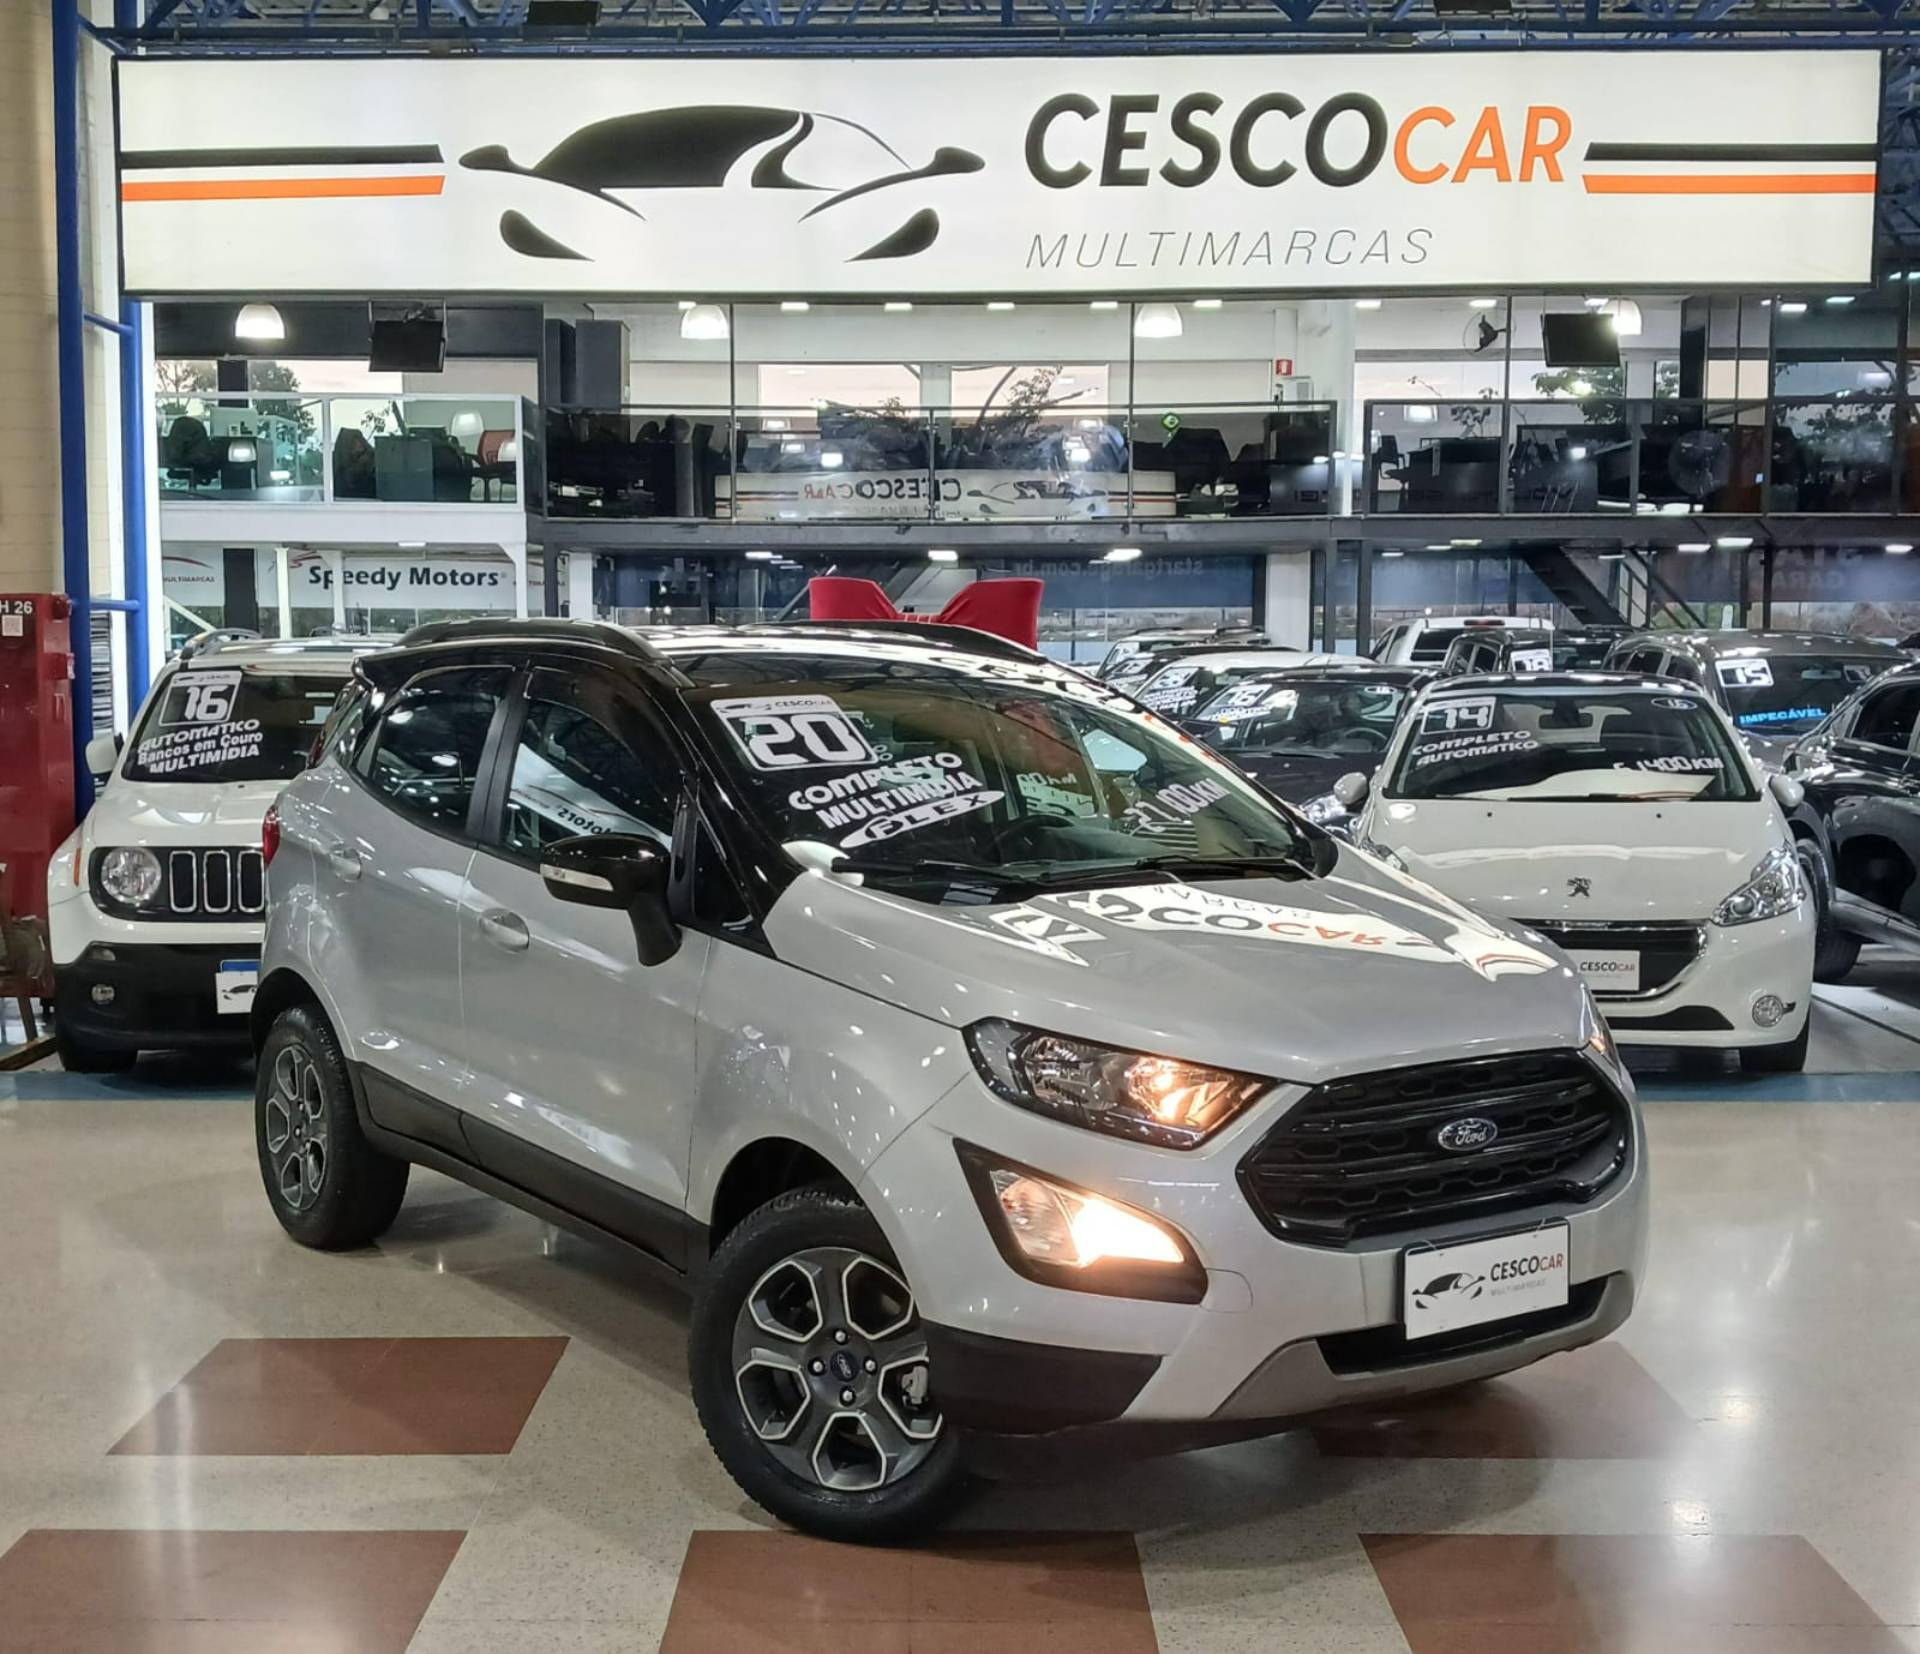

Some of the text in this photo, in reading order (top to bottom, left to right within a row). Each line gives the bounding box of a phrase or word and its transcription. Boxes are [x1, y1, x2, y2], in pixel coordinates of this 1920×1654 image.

[1024, 92, 1572, 188] CESCOCAR
[1026, 228, 1436, 269] MULTIMARCAS
[309, 566, 499, 590] Speedy Motors
[14, 601, 33, 614] 26
[184, 684, 229, 721] 16
[1444, 706, 1489, 730] 14
[137, 732, 263, 766] Bancos em Couro
[739, 712, 867, 766] 20
[1412, 730, 1532, 756] COMPLETO
[788, 752, 963, 811] COMPLETO
[867, 794, 989, 839] FLEX
[1579, 961, 1635, 972] CESCOCAR
[1455, 1123, 1489, 1146] Ford
[1490, 1252, 1564, 1282] CESCOCAR
